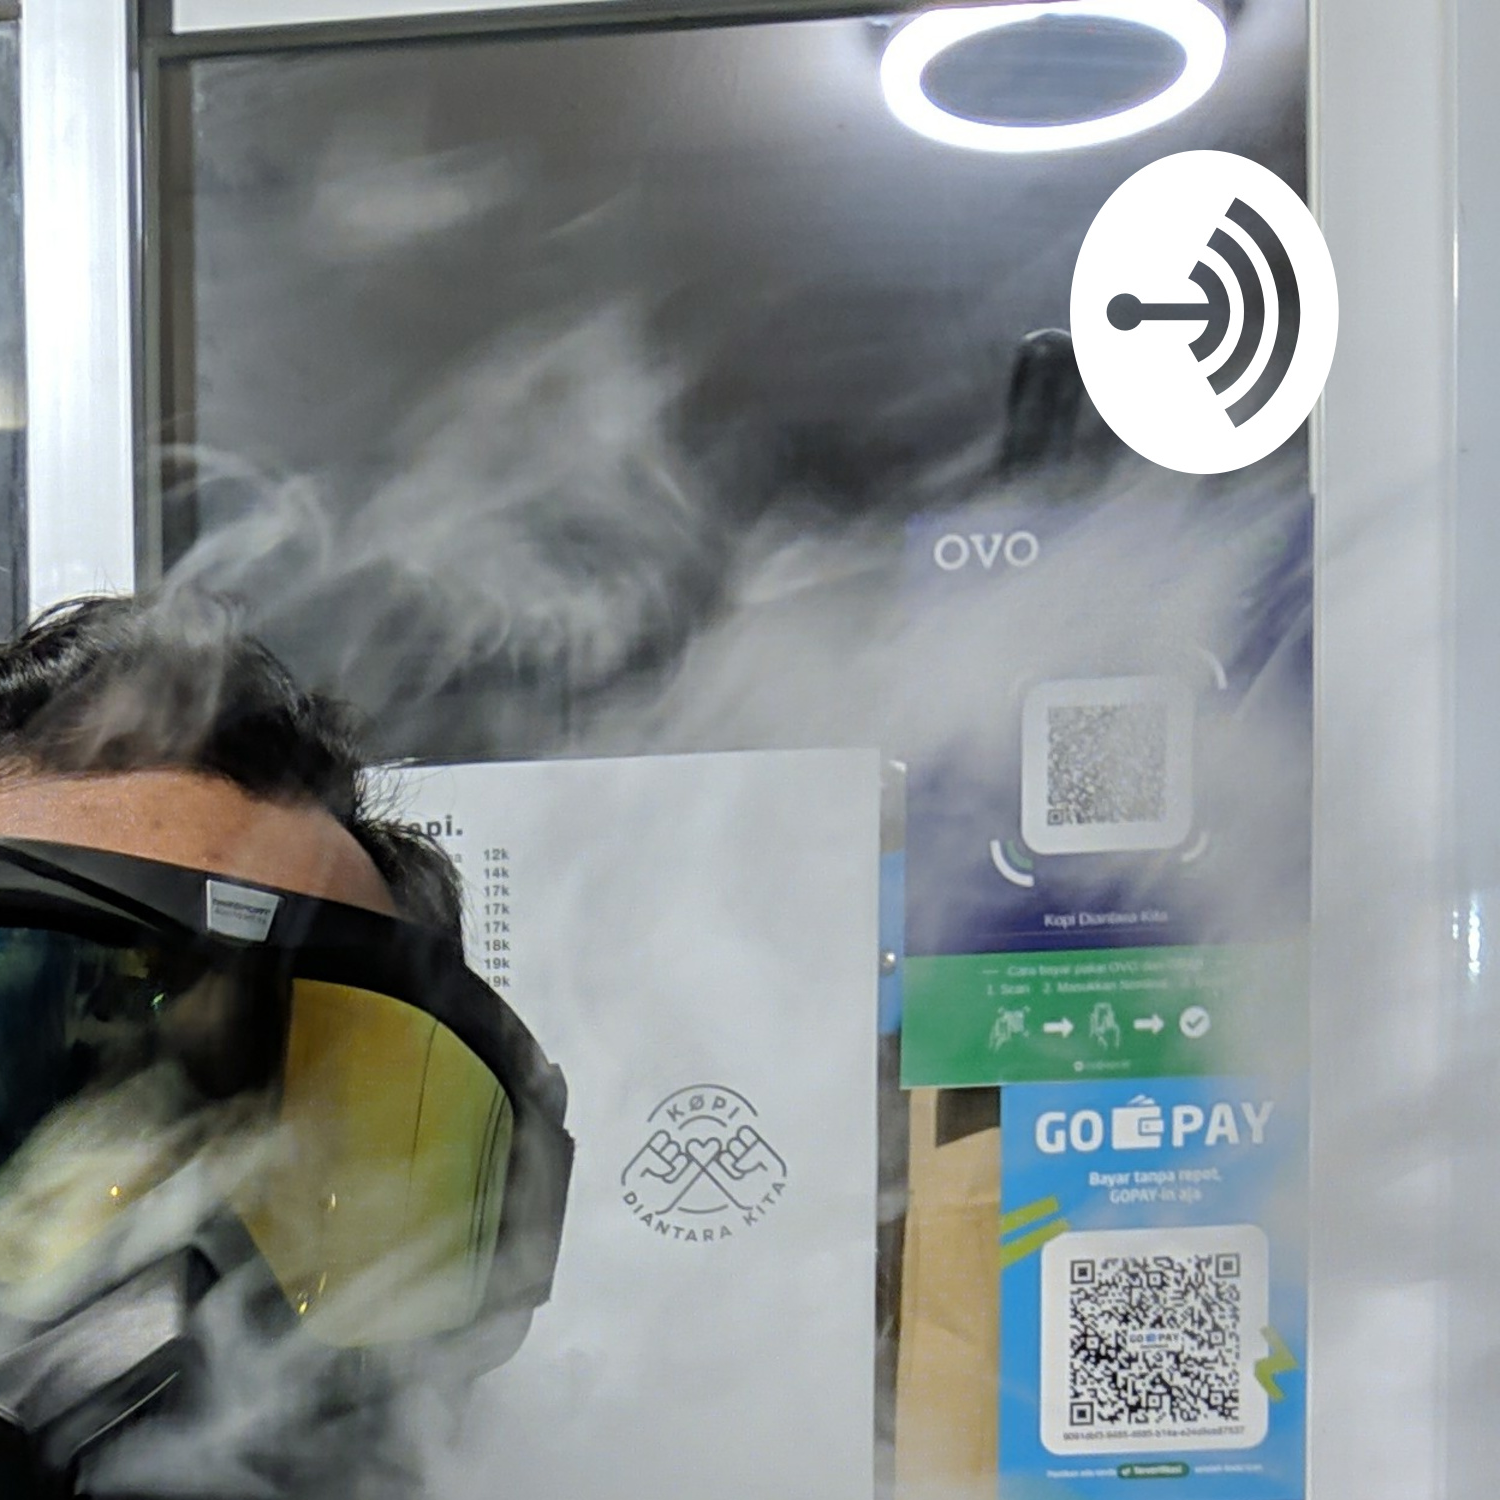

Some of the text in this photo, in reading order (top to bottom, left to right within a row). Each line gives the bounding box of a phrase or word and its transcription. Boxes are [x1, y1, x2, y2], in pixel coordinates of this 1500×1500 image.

[933, 530, 1040, 571] OVO
[483, 849, 510, 861] 12k
[483, 867, 510, 879] 14k
[483, 885, 510, 897] 17k
[483, 903, 510, 915] 17k
[483, 922, 510, 934] 17k
[483, 940, 510, 952] 18k
[483, 958, 510, 970] 19k
[1035, 1101, 1275, 1154] GO PAY
[1089, 1170, 1130, 1187] Bayar
[1134, 1169, 1175, 1186] tanpa
[623, 1181, 786, 1242] DIANTARA KITA
